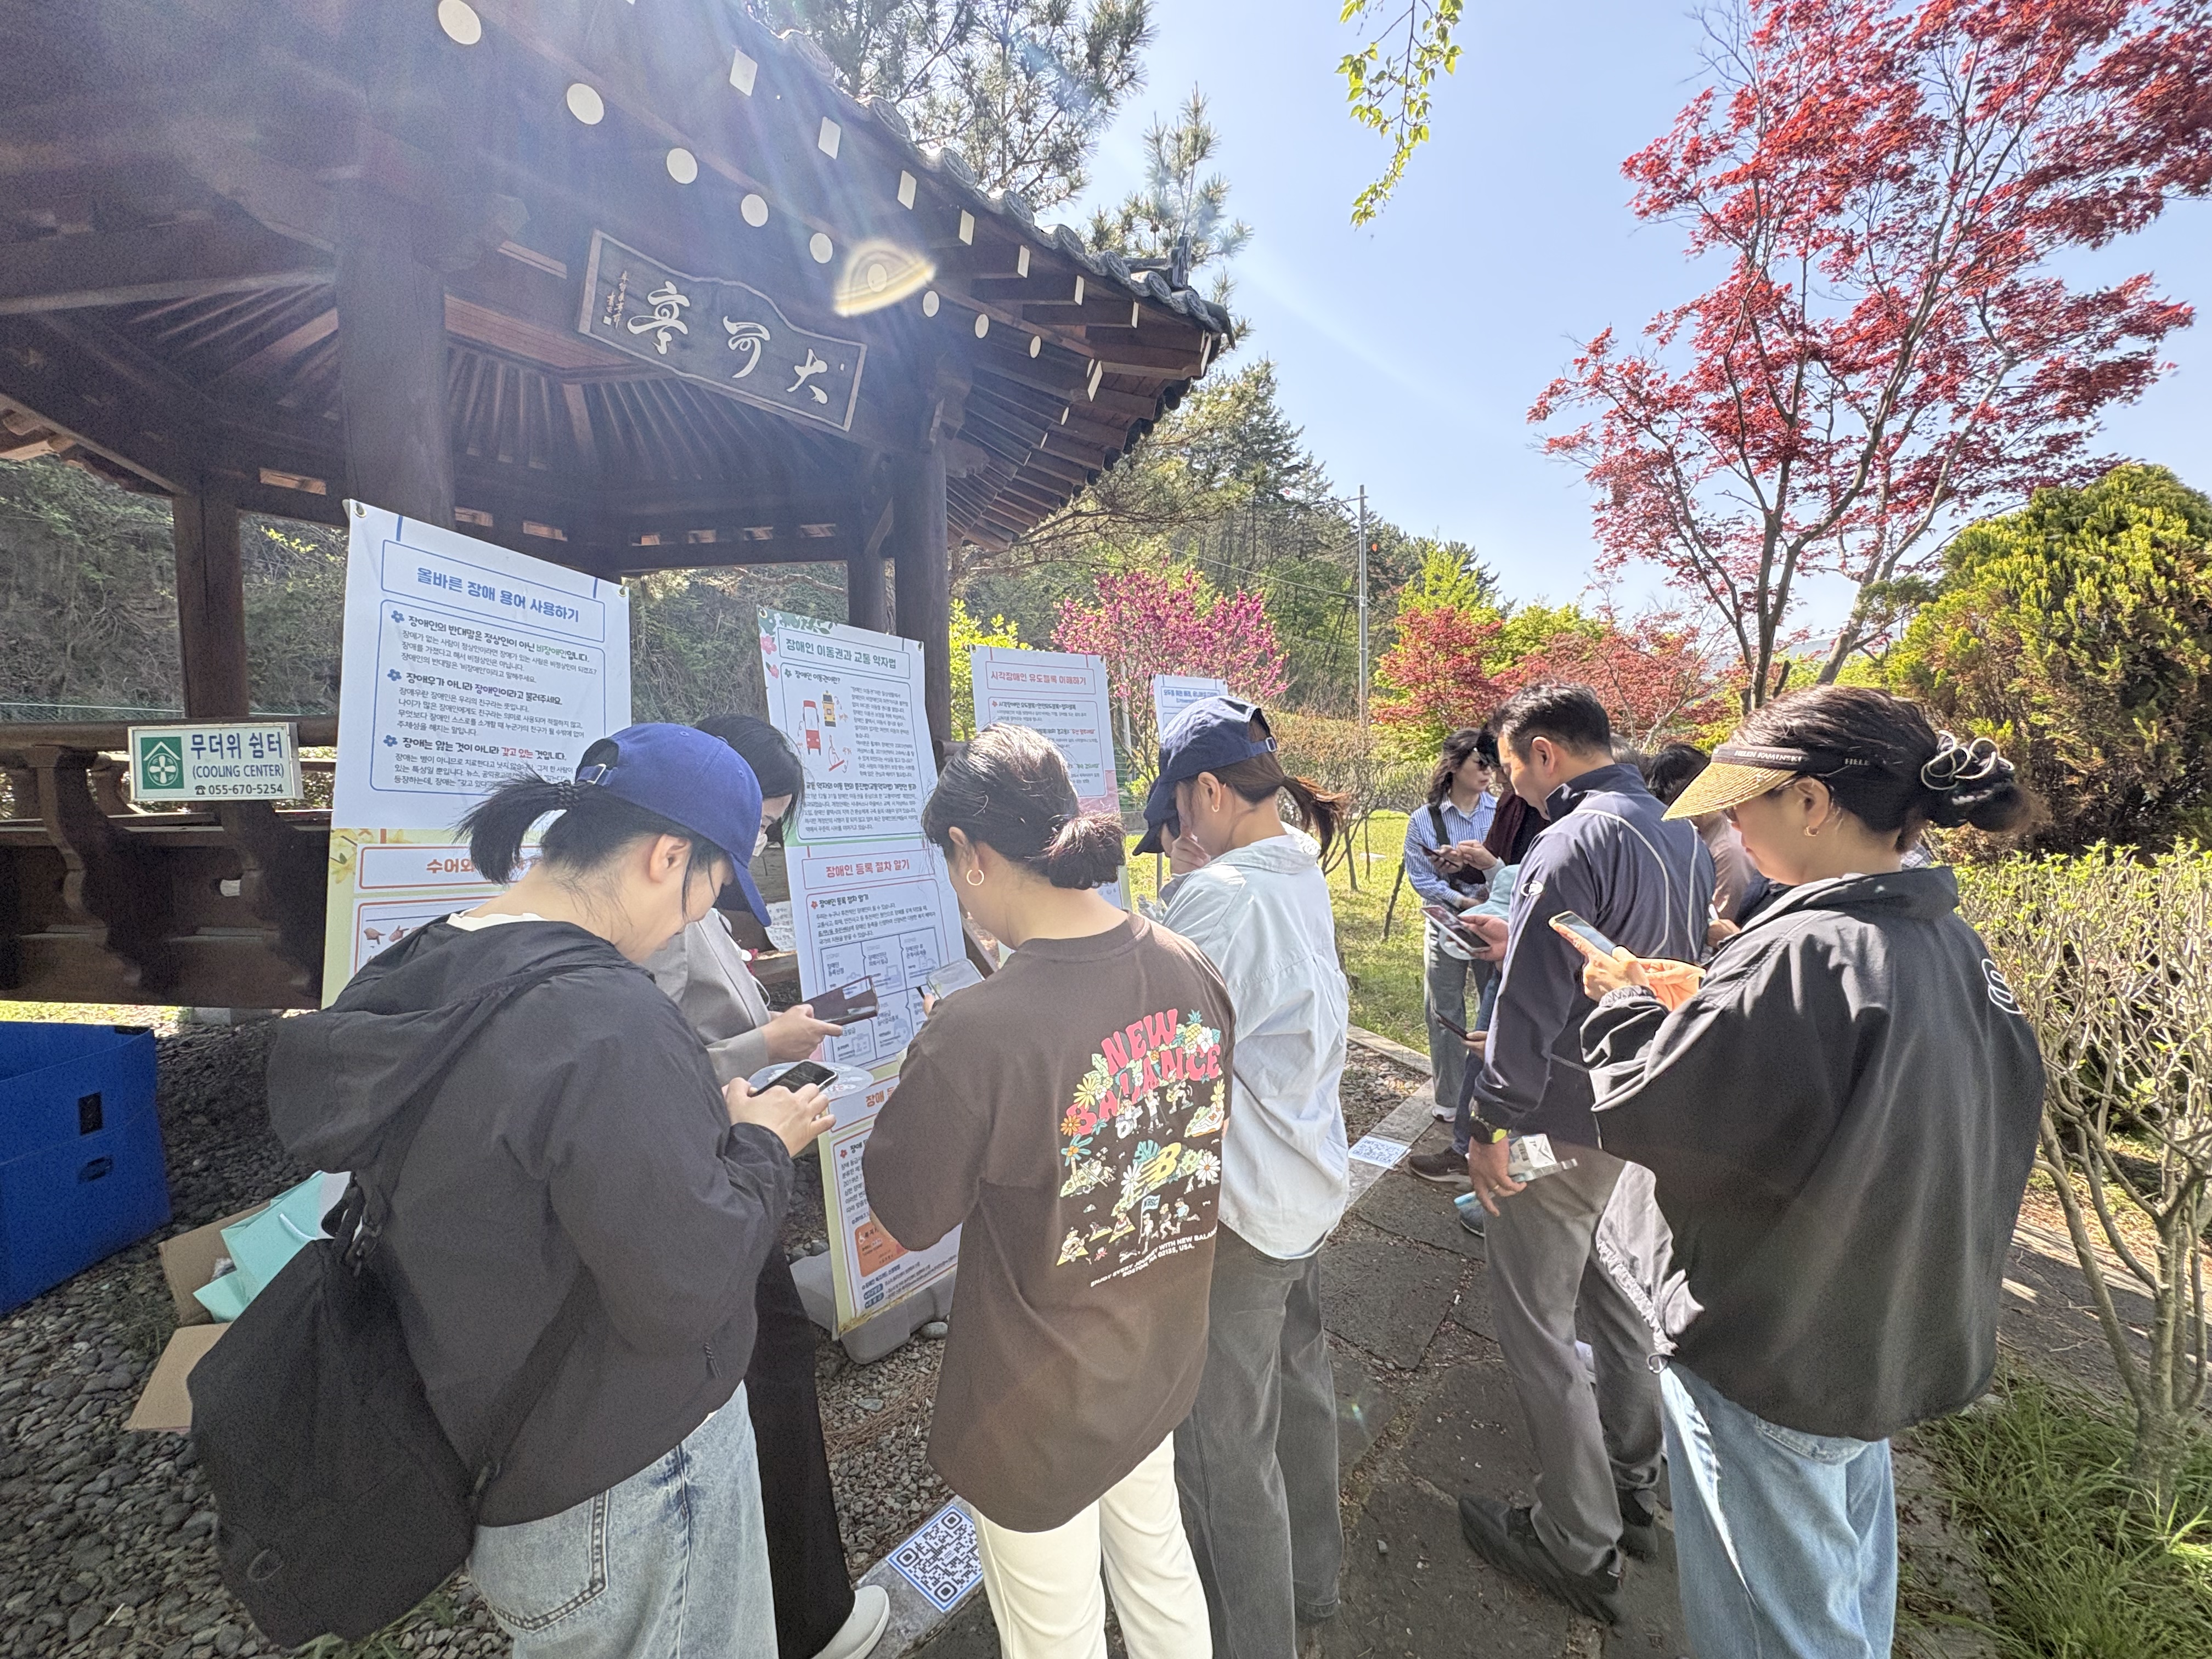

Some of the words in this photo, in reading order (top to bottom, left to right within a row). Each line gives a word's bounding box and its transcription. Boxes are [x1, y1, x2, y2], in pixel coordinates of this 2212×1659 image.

[416, 566, 462, 593] 올바른
[467, 580, 495, 601] 장애
[500, 589, 526, 609] 용어
[529, 597, 578, 623] 사용하기
[408, 616, 446, 633] 장애인의
[448, 624, 482, 641] 반대말은
[484, 633, 516, 648] 정상인이
[518, 640, 534, 652] 아닌
[401, 652, 430, 664] 장애인의
[432, 658, 458, 669] 반대말은
[402, 630, 424, 642] 장애가
[425, 635, 439, 645] 없는
[441, 638, 459, 648] 사람이
[461, 642, 498, 656] 정상인이라면
[500, 650, 517, 660] 장애가
[519, 654, 530, 663] 있는
[532, 656, 548, 666] 사람은
[550, 660, 576, 672] 비정상인이
[402, 641, 422, 652] 장애를
[425, 646, 451, 657] 가졌다고
[453, 651, 465, 661] 해서
[467, 654, 498, 667] 비정상인은
[786, 638, 814, 654] 장애인
[816, 644, 852, 662] 이동권과
[854, 651, 871, 664] 교통
[872, 654, 896, 669] 약자법
[405, 672, 444, 688] 장애우가
[447, 679, 472, 691] 아니라
[475, 684, 523, 700] 장애인이라고
[991, 671, 1026, 681] 시각장애인
[1029, 674, 1057, 684] 유도블록
[1059, 675, 1086, 685] 이해하기
[399, 687, 428, 698] 장애우란
[430, 691, 456, 702] 장애인은
[459, 695, 477, 705] 우리의
[479, 698, 502, 708] 친구라는
[398, 698, 420, 708] 나이가
[422, 701, 437, 710] 많은
[439, 703, 476, 715] 장애인에게도
[478, 709, 502, 719] 친구라는
[504, 712, 521, 721] 의미로
[523, 715, 545, 724] 사용되어
[398, 709, 427, 720] 무엇보다
[429, 713, 449, 723] 장애인
[190, 733, 241, 759] 무더위
[249, 732, 283, 759] 쉼터
[402, 737, 432, 750] 장애는
[435, 740, 453, 752] 앓는
[455, 742, 472, 753] 것이
[475, 744, 499, 754] 아니라
[501, 747, 516, 757] 갖고
[518, 748, 533, 759] 있는
[535, 750, 566, 761] 것입니다.
[395, 753, 417, 762] 장애는
[420, 755, 435, 763] 병이
[1757, 752, 1802, 762] KAMINSKI
[193, 765, 240, 780] (COOLING
[244, 764, 285, 778] CENTER)
[394, 764, 410, 772] 있는
[208, 784, 284, 794] 055-670-5254
[826, 864, 853, 878] 장애인
[855, 862, 873, 875] 등록
[875, 860, 892, 872] 절차
[893, 858, 910, 871] 알기
[819, 898, 836, 908] 장애인
[1101, 1008, 1178, 1075] NEW
[866, 1090, 884, 1107] 장애
[1179, 1243, 1195, 1251] USA.
[1091, 1274, 1111, 1287] ENJOY
[1113, 1263, 1133, 1277] EVERY
[1159, 1241, 1176, 1250] WITH
[1177, 1236, 1193, 1245] NEW
